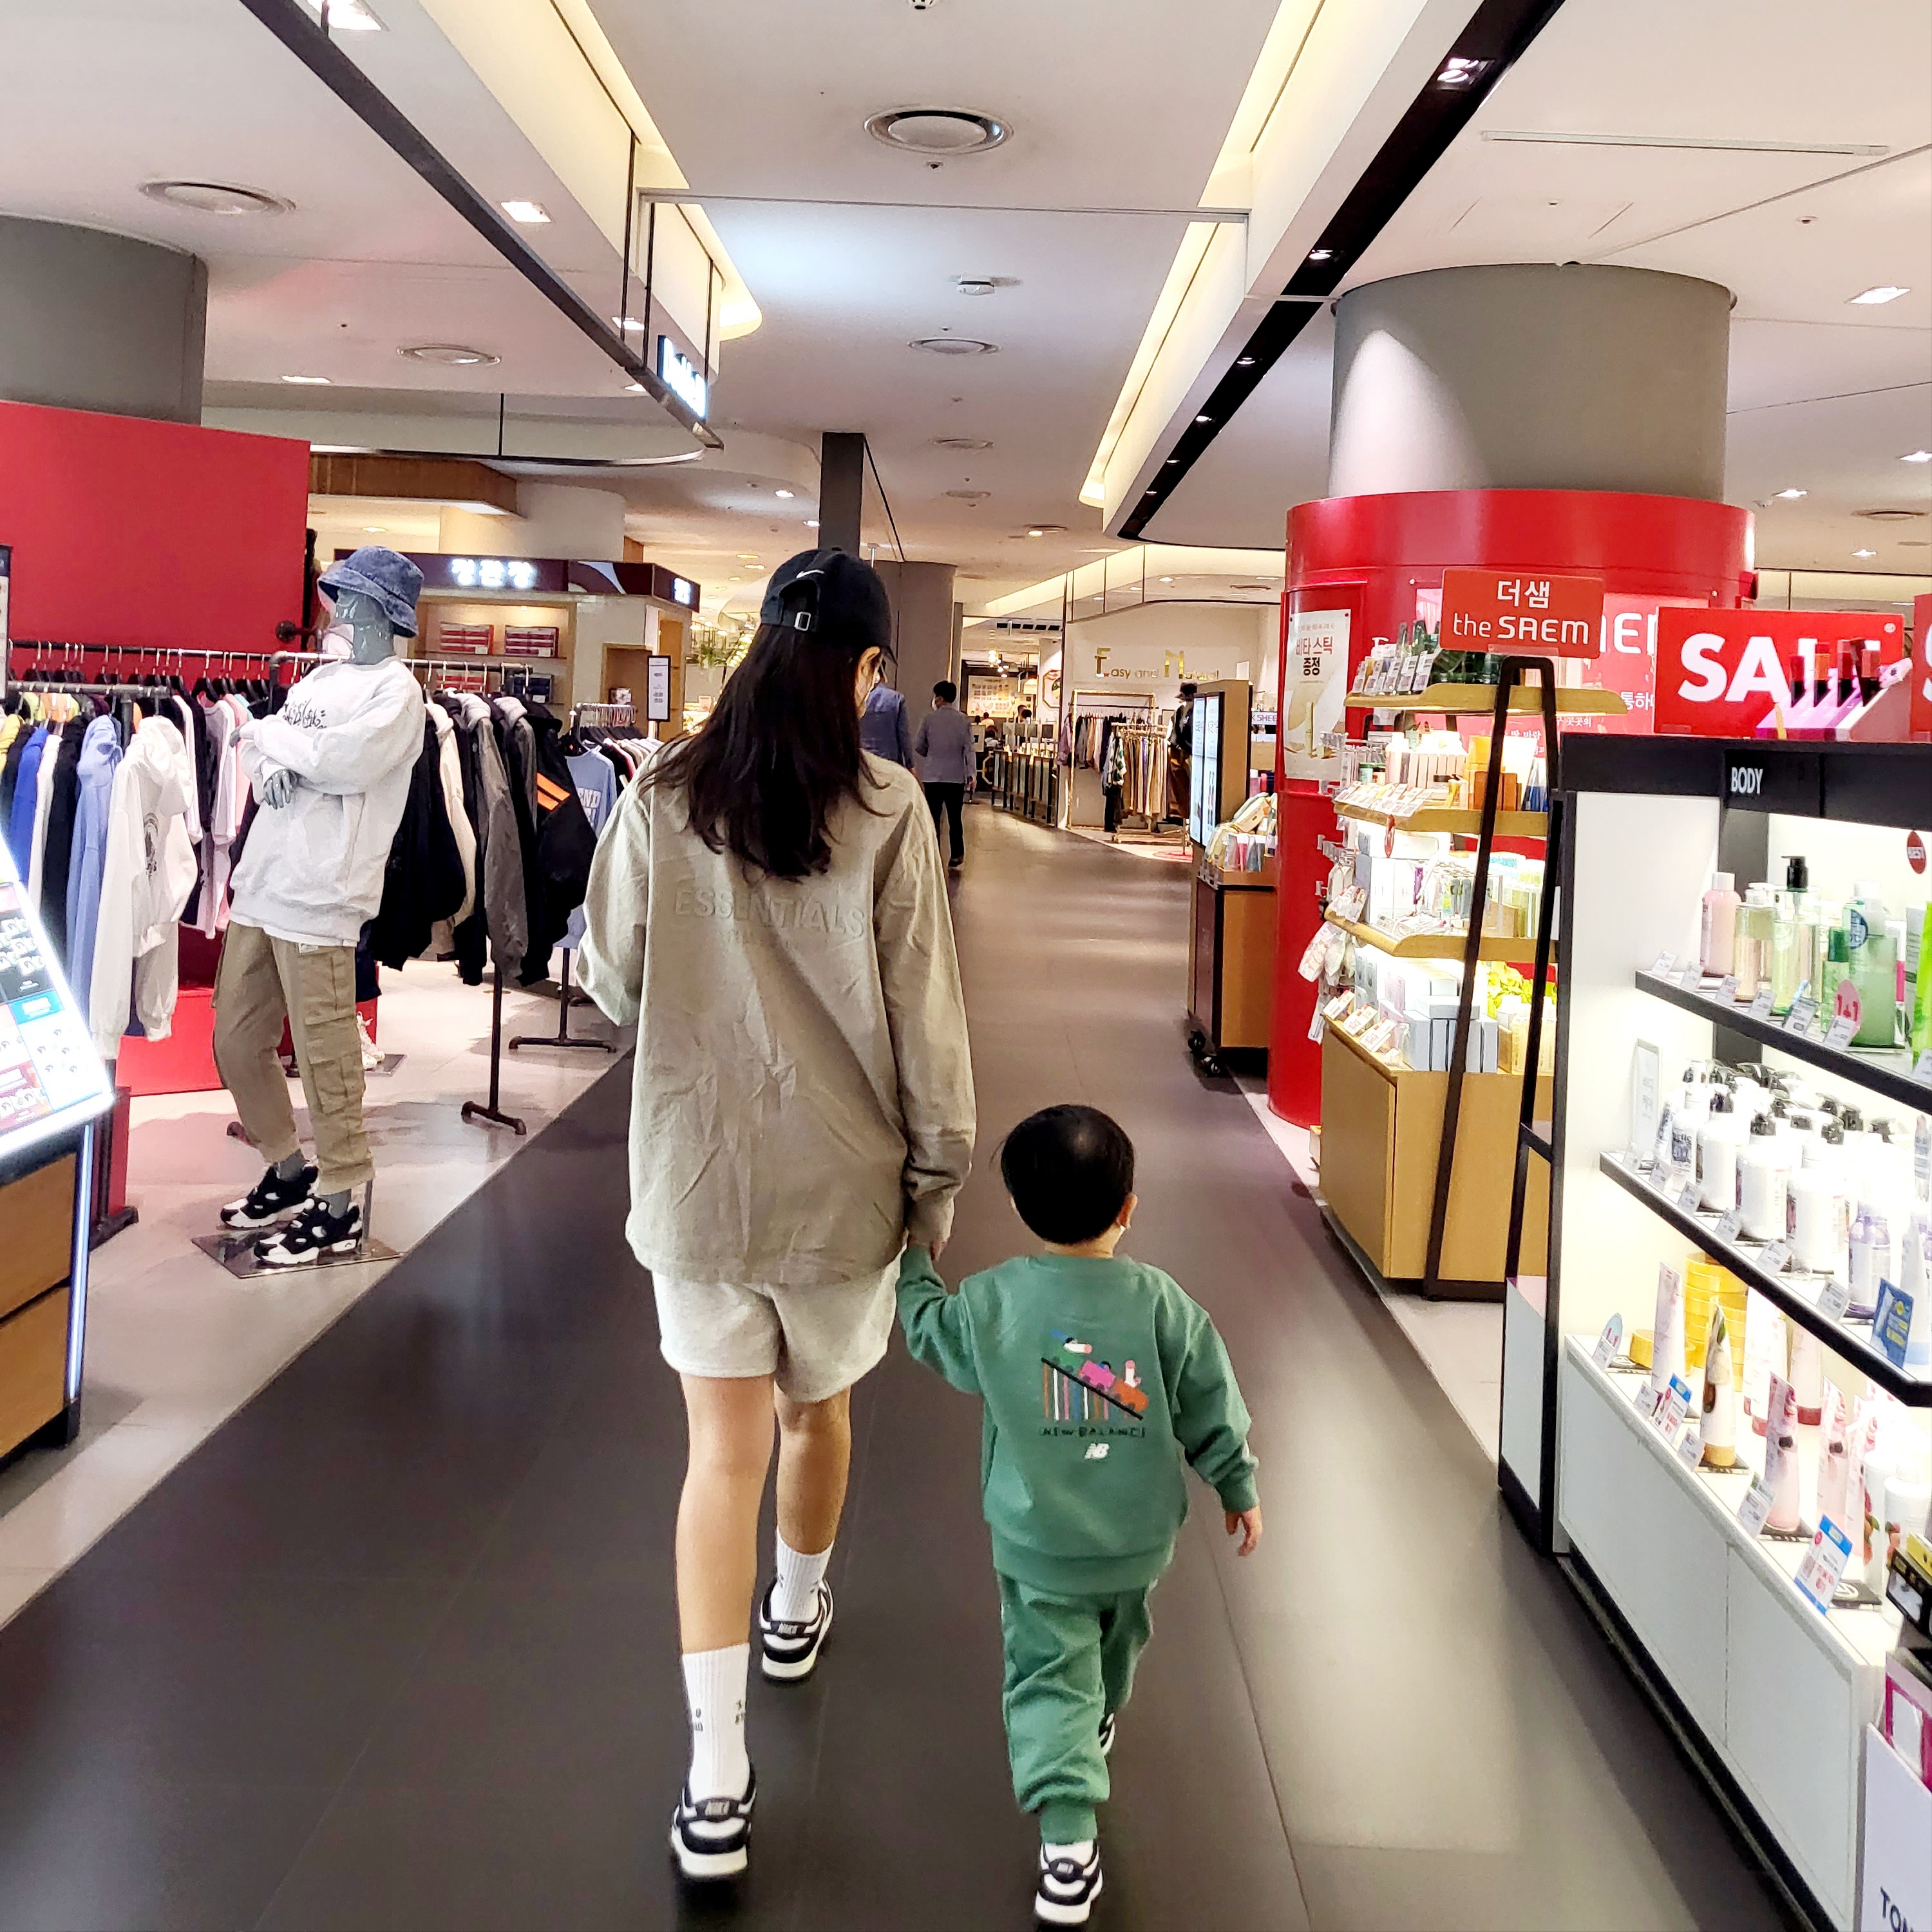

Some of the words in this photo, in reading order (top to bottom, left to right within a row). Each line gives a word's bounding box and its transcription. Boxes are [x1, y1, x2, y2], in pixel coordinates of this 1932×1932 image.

[1497, 580, 1550, 609] 더샘
[1453, 612, 1491, 638] the
[1497, 616, 1589, 645] SAEM
[1095, 647, 1132, 680] Easy
[1303, 657, 1320, 676] 증정
[1730, 767, 1764, 794] BODY
